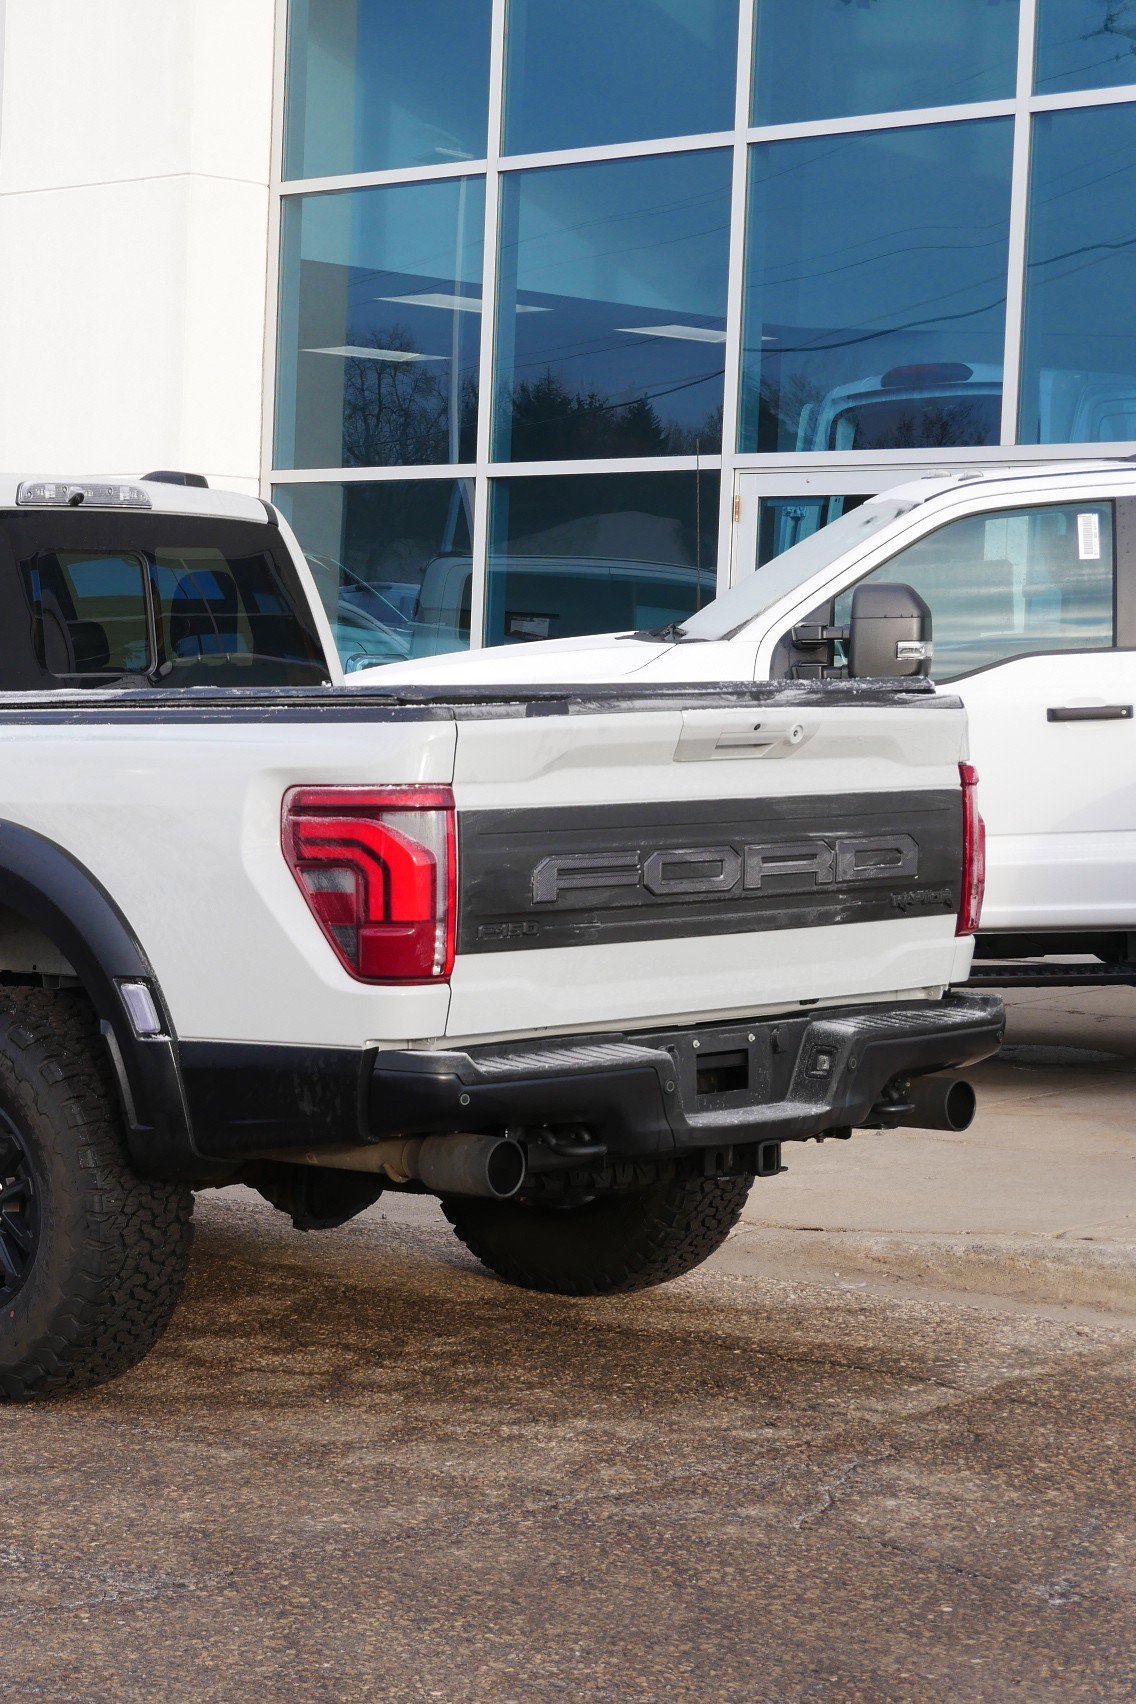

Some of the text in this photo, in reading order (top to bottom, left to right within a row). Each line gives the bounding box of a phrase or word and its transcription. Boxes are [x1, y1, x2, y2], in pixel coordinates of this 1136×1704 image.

[530, 832, 920, 906] FORD
[890, 888, 953, 914] RAPTOR
[475, 919, 540, 941] F-150
